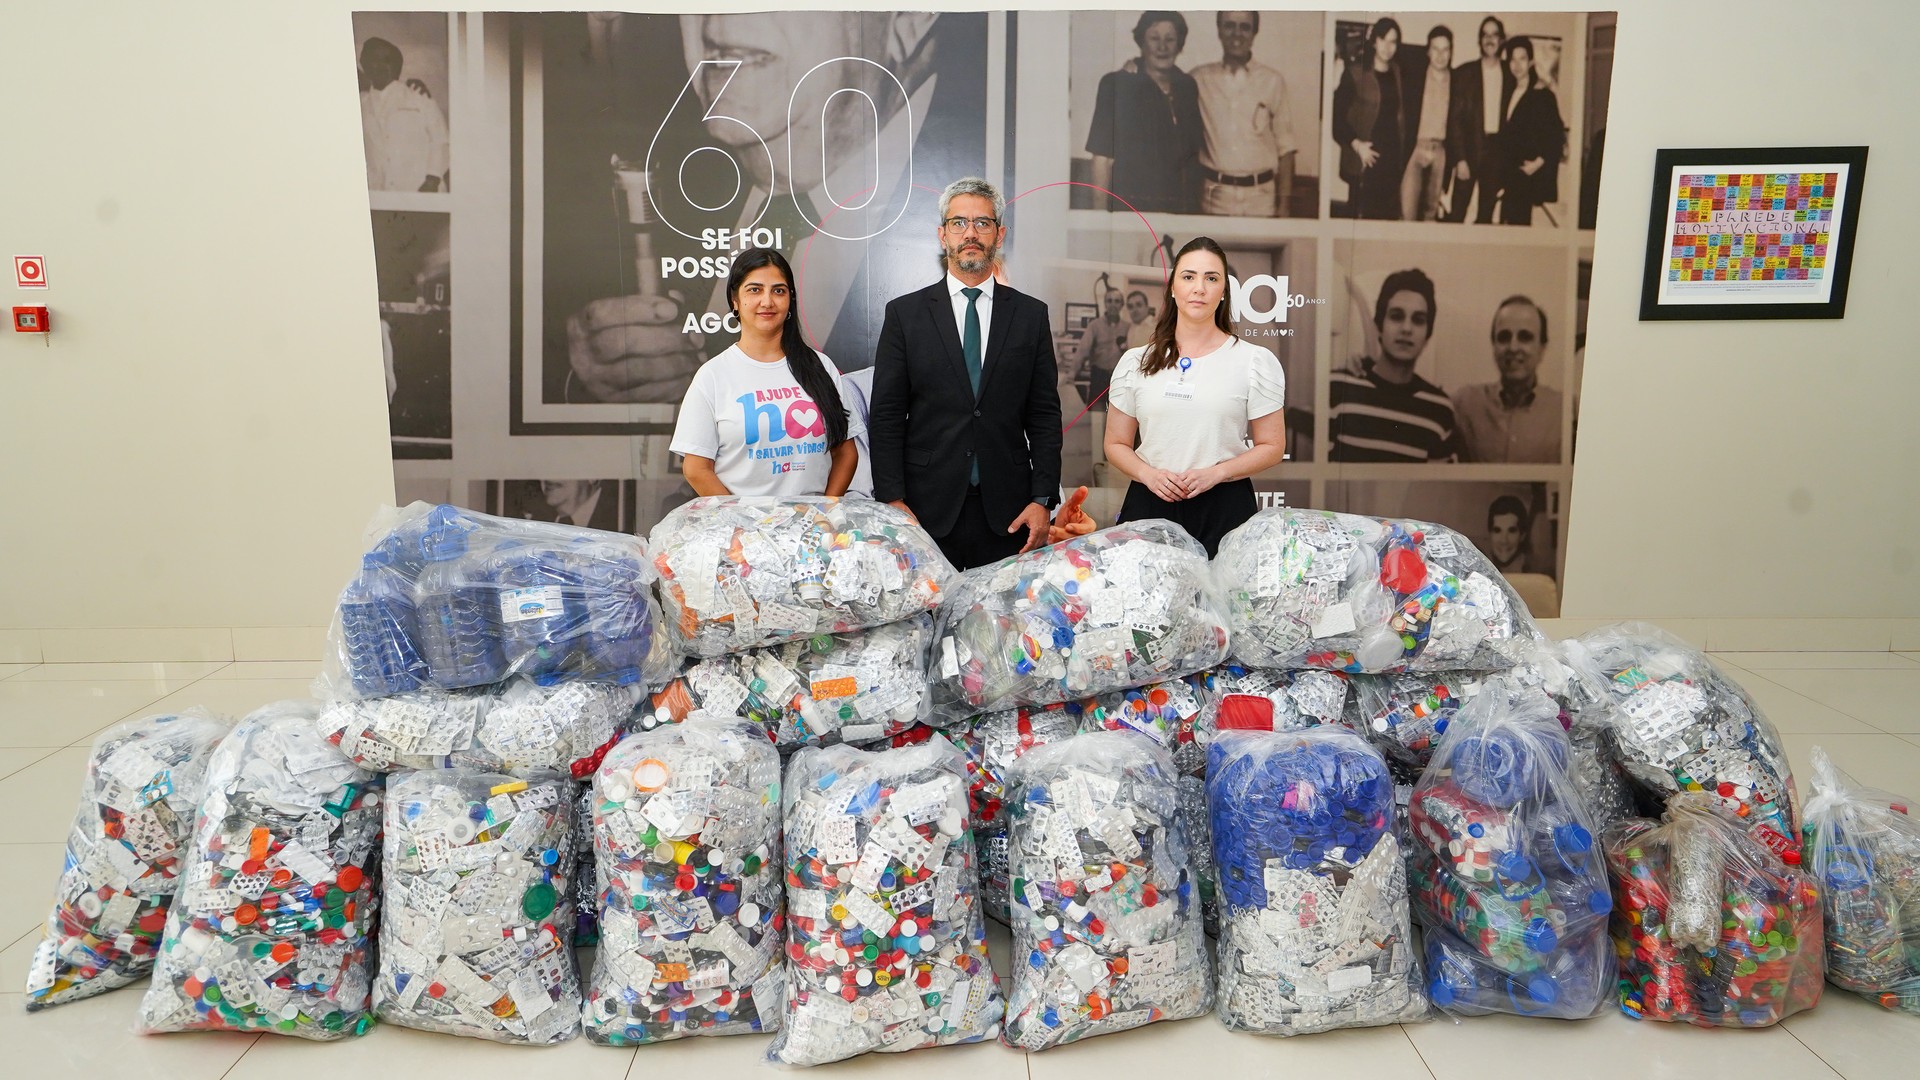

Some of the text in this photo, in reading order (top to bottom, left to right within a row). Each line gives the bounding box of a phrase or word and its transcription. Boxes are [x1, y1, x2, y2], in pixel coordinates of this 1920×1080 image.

[645, 57, 913, 241] 60
[1714, 211, 1791, 223] PAREDE
[1675, 222, 1830, 235] MOTIVACIONAL
[701, 227, 783, 251] SE FOI
[1286, 293, 1305, 308] 60
[1244, 328, 1258, 337] DE
[756, 387, 801, 402] AJUDE
[756, 446, 793, 459] SALVAR
